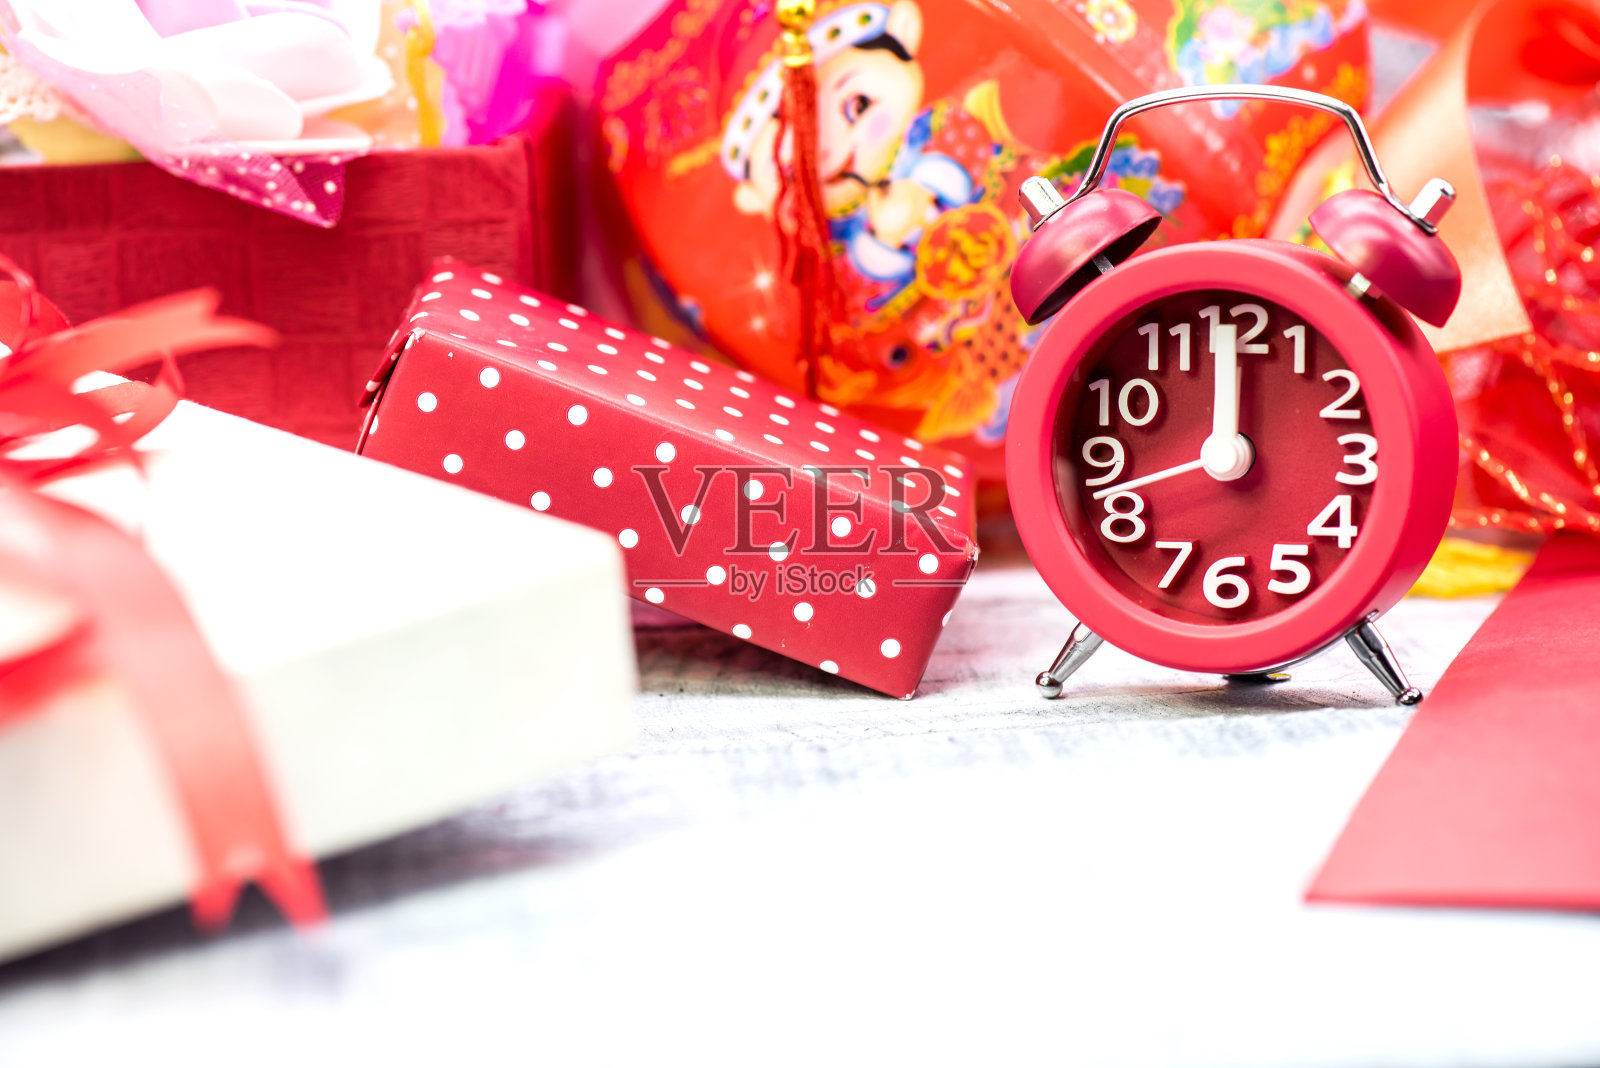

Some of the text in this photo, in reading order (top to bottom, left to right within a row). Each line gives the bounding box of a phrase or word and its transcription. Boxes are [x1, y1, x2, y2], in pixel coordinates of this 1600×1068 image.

[1138, 322, 1191, 371] 11
[1199, 303, 1269, 355] 12
[1283, 325, 1306, 374] 1
[1089, 378, 1159, 427] 10
[1319, 369, 1361, 419] 2
[1081, 436, 1125, 487] 9
[1334, 433, 1379, 485] 3
[1100, 490, 1146, 543] 8
[1307, 494, 1358, 549] 4
[1155, 540, 1194, 589] 7
[1202, 556, 1250, 609] 6
[1267, 543, 1311, 595] 5
